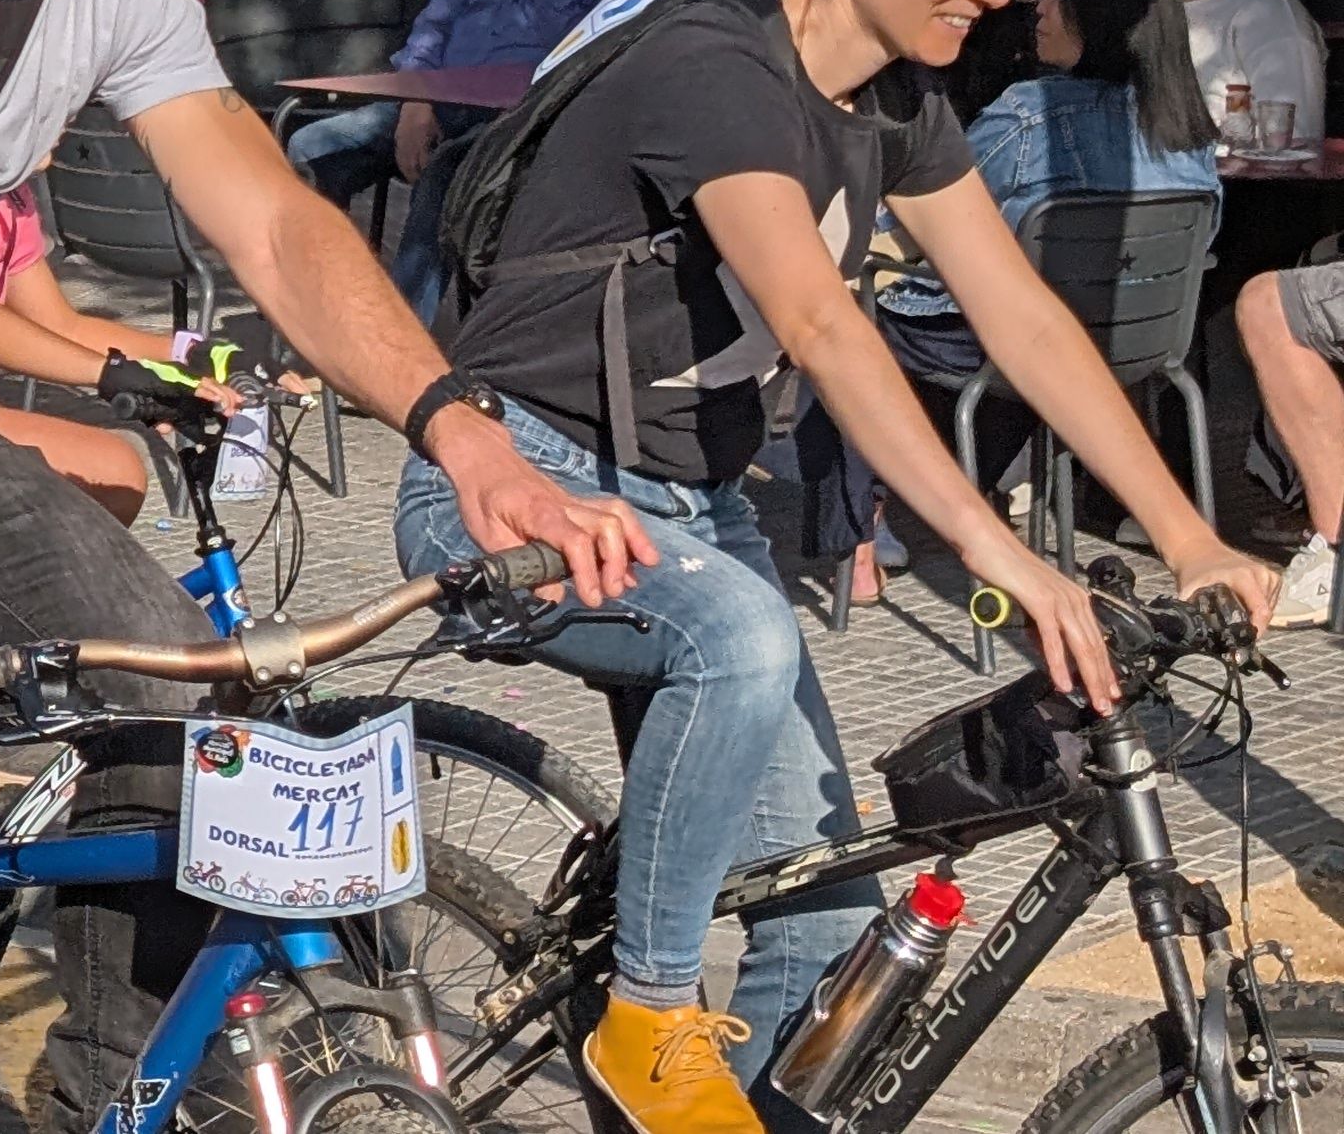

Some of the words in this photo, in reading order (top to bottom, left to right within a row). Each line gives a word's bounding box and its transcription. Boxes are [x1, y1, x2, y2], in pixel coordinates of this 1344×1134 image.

[248, 746, 376, 778] BICICLETADA
[272, 781, 362, 803] MERCAT
[208, 824, 290, 859] DORSAL
[288, 796, 366, 853] 117
